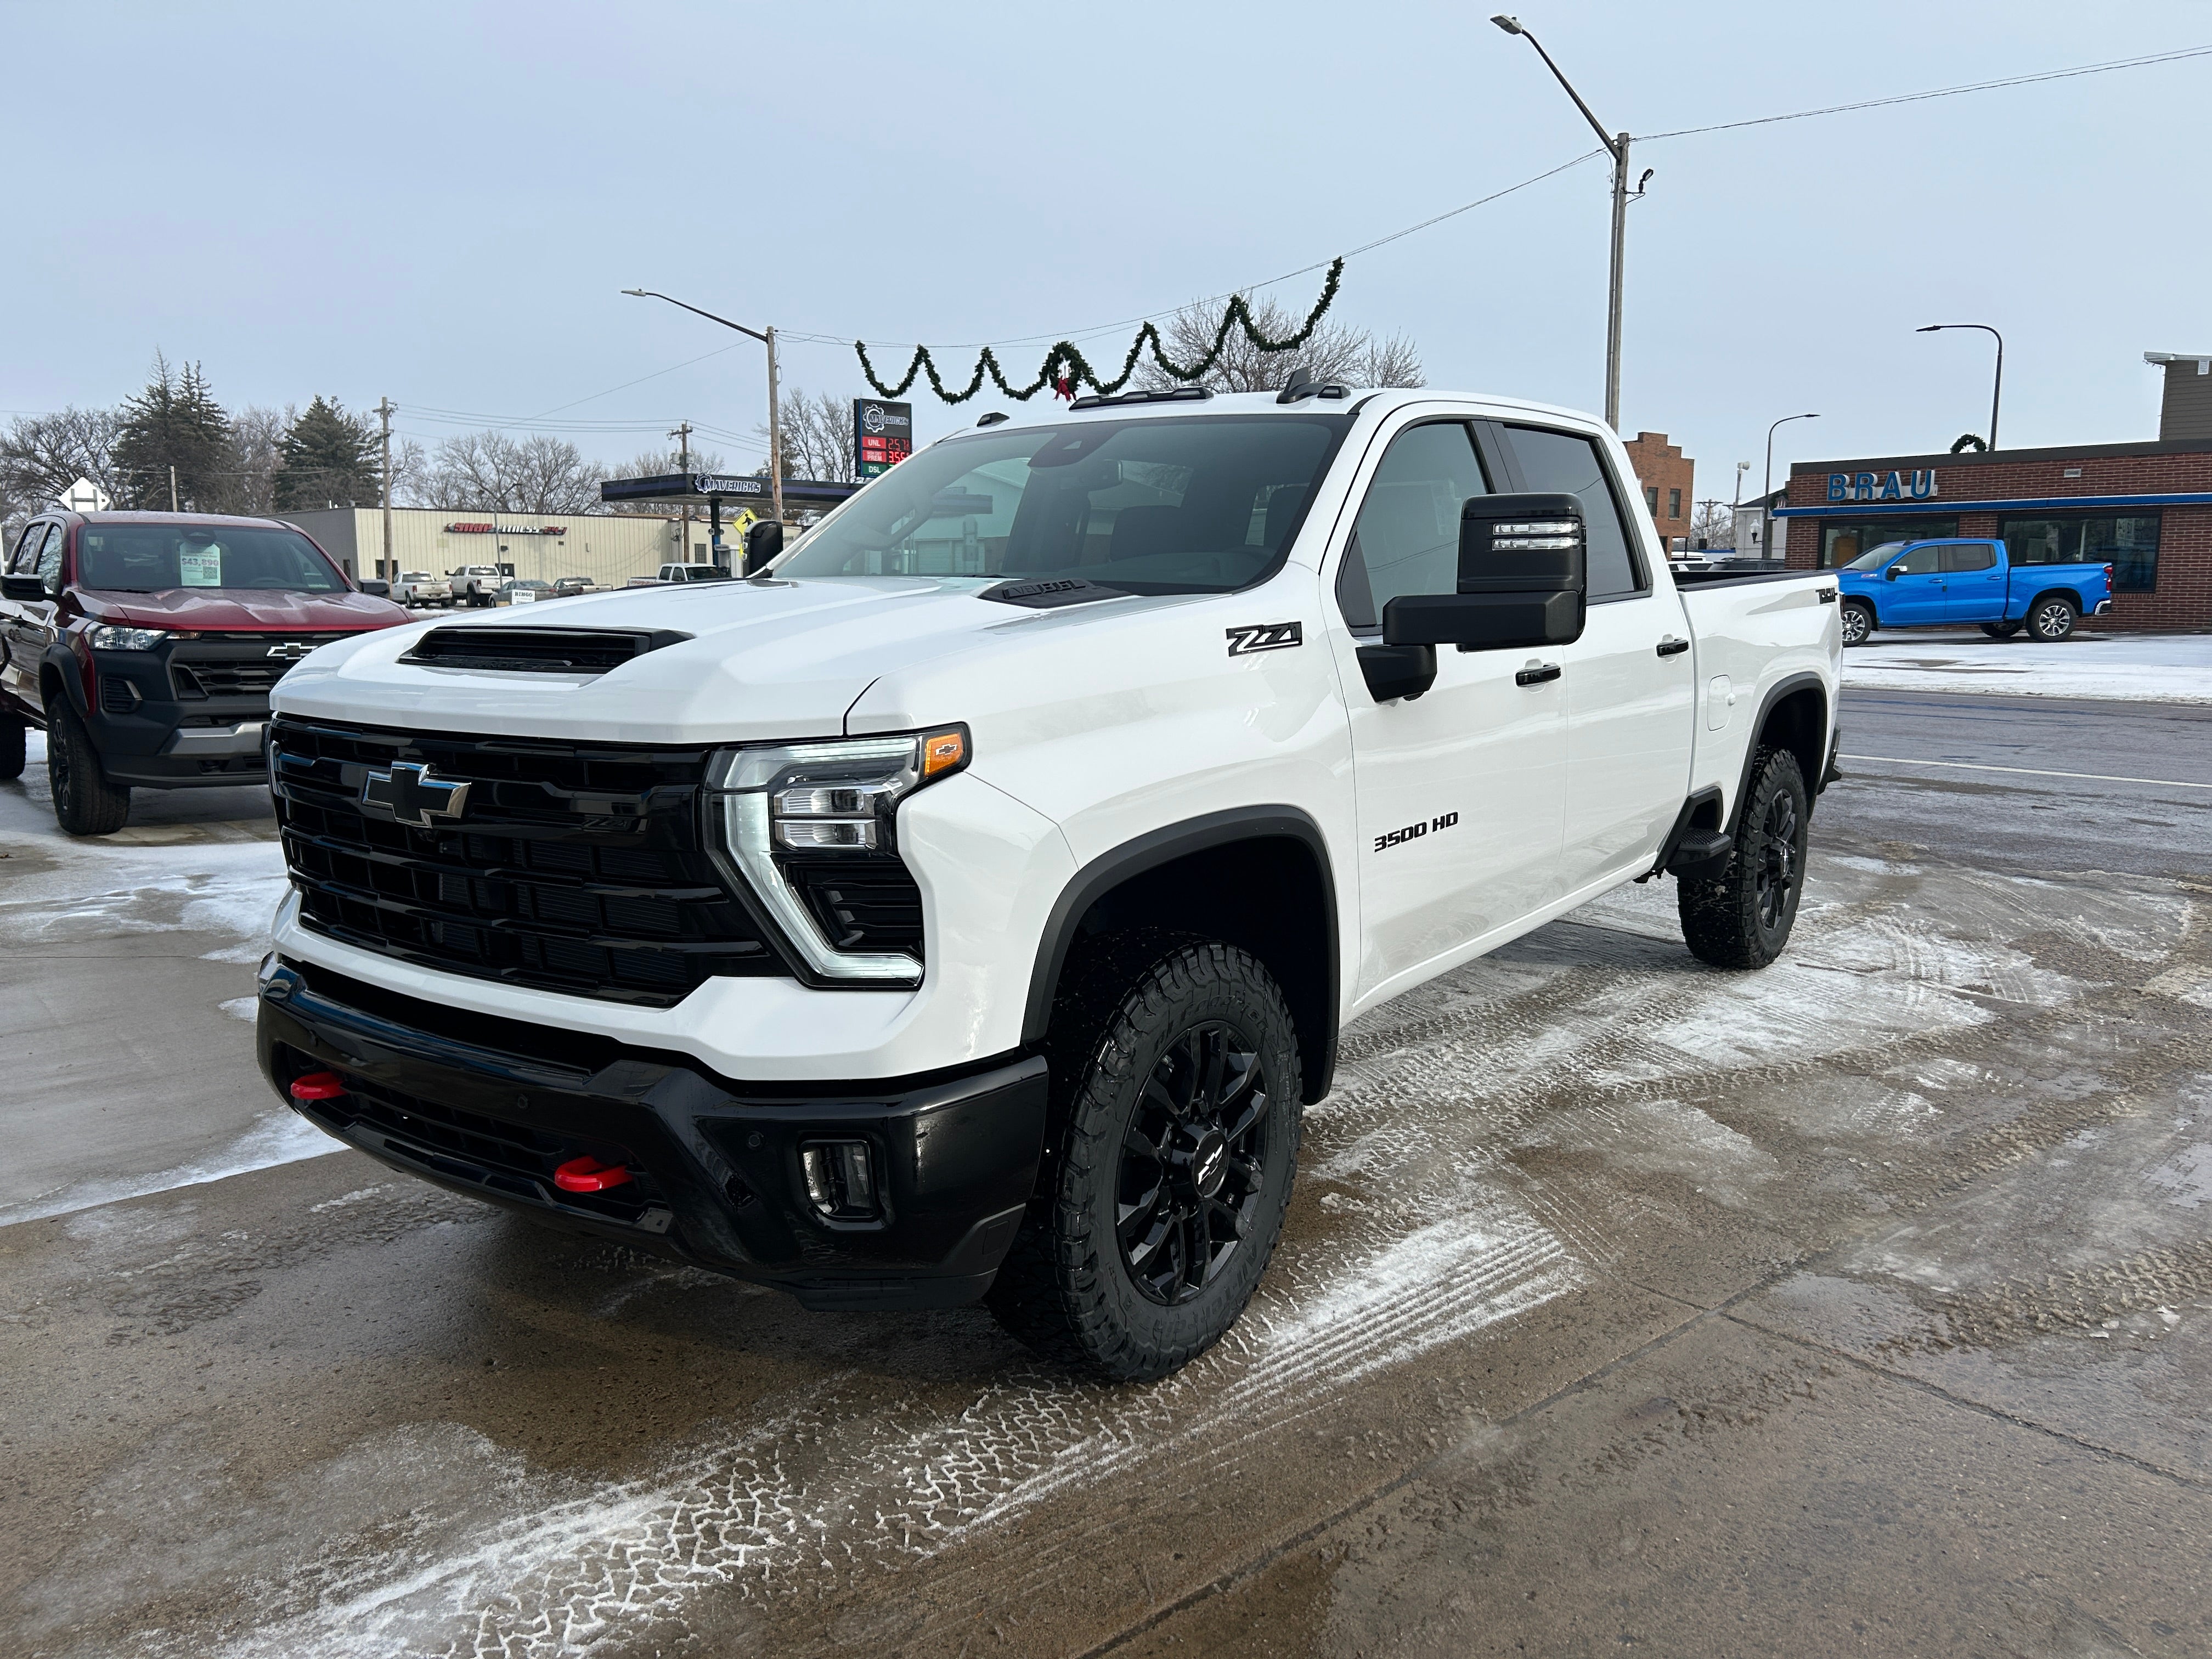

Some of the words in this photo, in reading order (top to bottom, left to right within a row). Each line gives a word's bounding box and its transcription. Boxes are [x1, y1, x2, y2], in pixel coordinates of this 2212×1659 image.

[868, 465, 881, 473] DSL
[1827, 470, 1936, 501] BRAU
[182, 557, 219, 567] $43,890
[1226, 621, 1303, 657] Z71
[1374, 821, 1427, 853] 3500
[1432, 811, 1458, 832] HD
